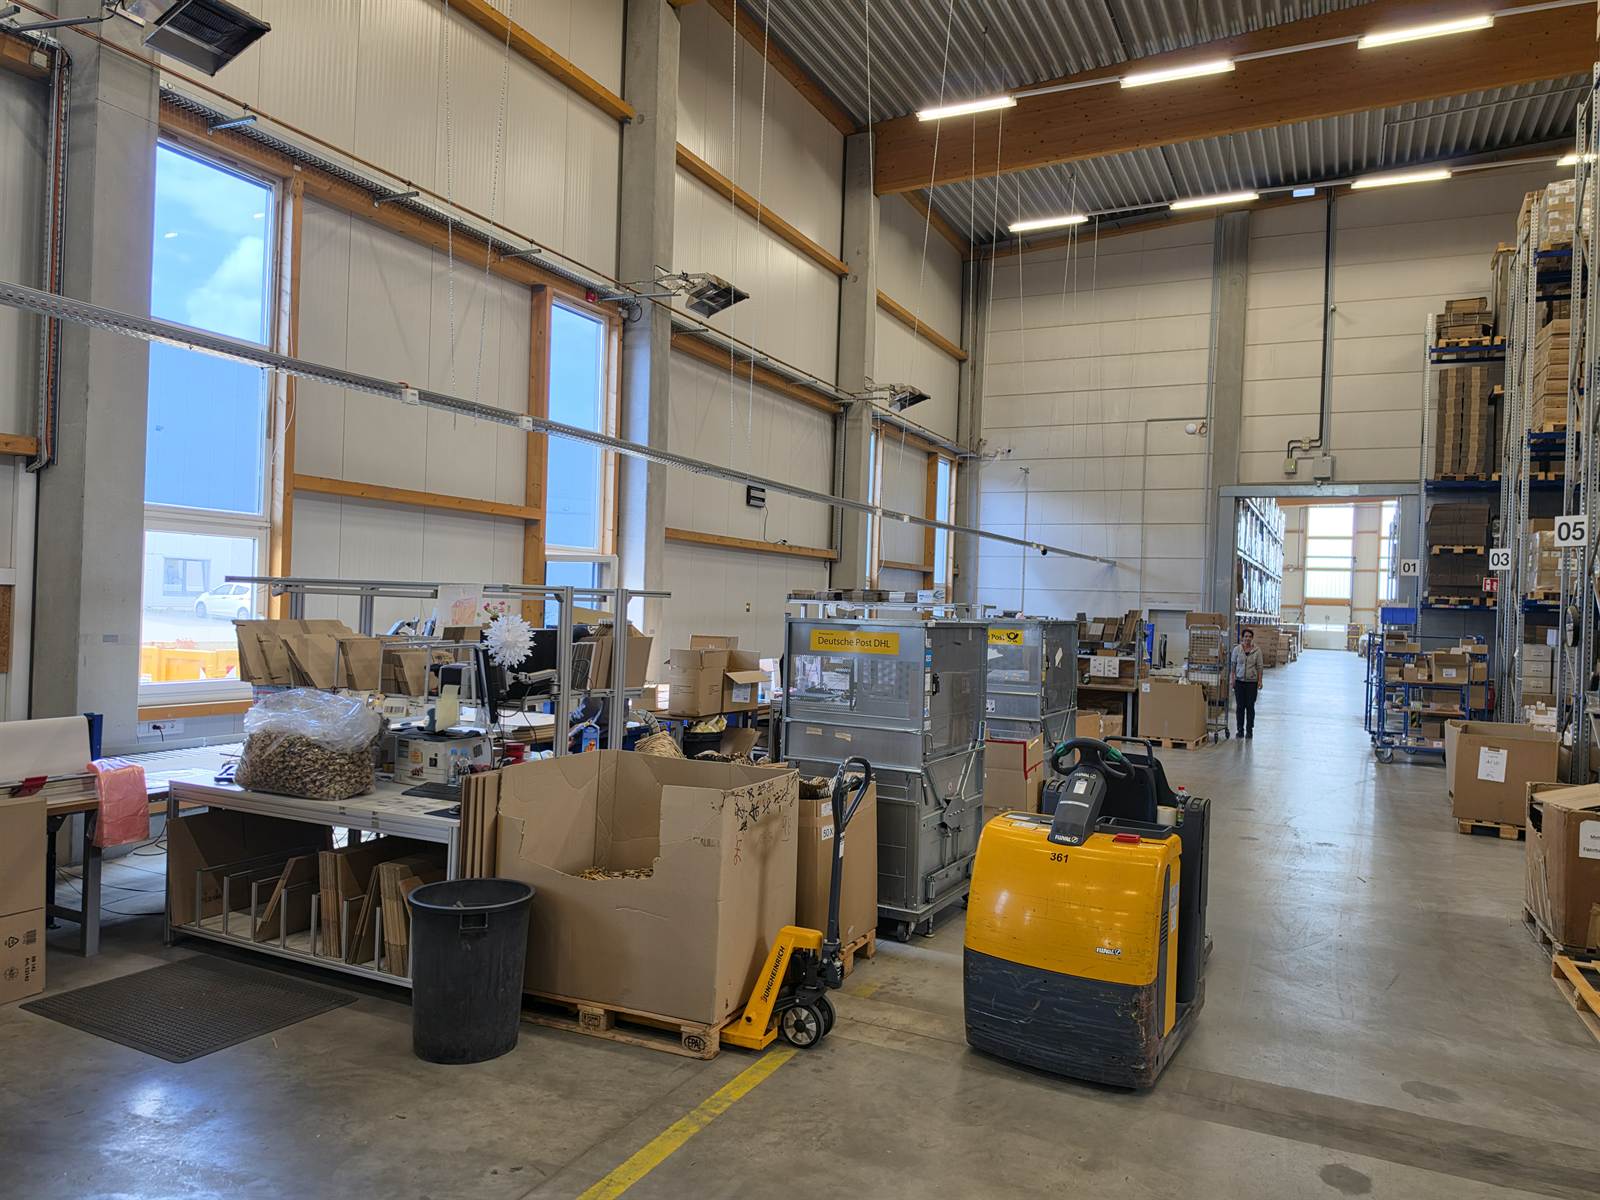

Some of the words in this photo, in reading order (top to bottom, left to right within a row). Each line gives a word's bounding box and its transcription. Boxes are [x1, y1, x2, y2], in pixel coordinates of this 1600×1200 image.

[1557, 522, 1585, 541] 05
[1491, 553, 1510, 566] 03
[1402, 563, 1417, 573] 01
[817, 636, 854, 647] Deutsche
[856, 638, 872, 647] Post
[873, 639, 891, 649] DHL
[1050, 852, 1069, 863] 361
[762, 945, 785, 1003] JUNGHEINRICH
